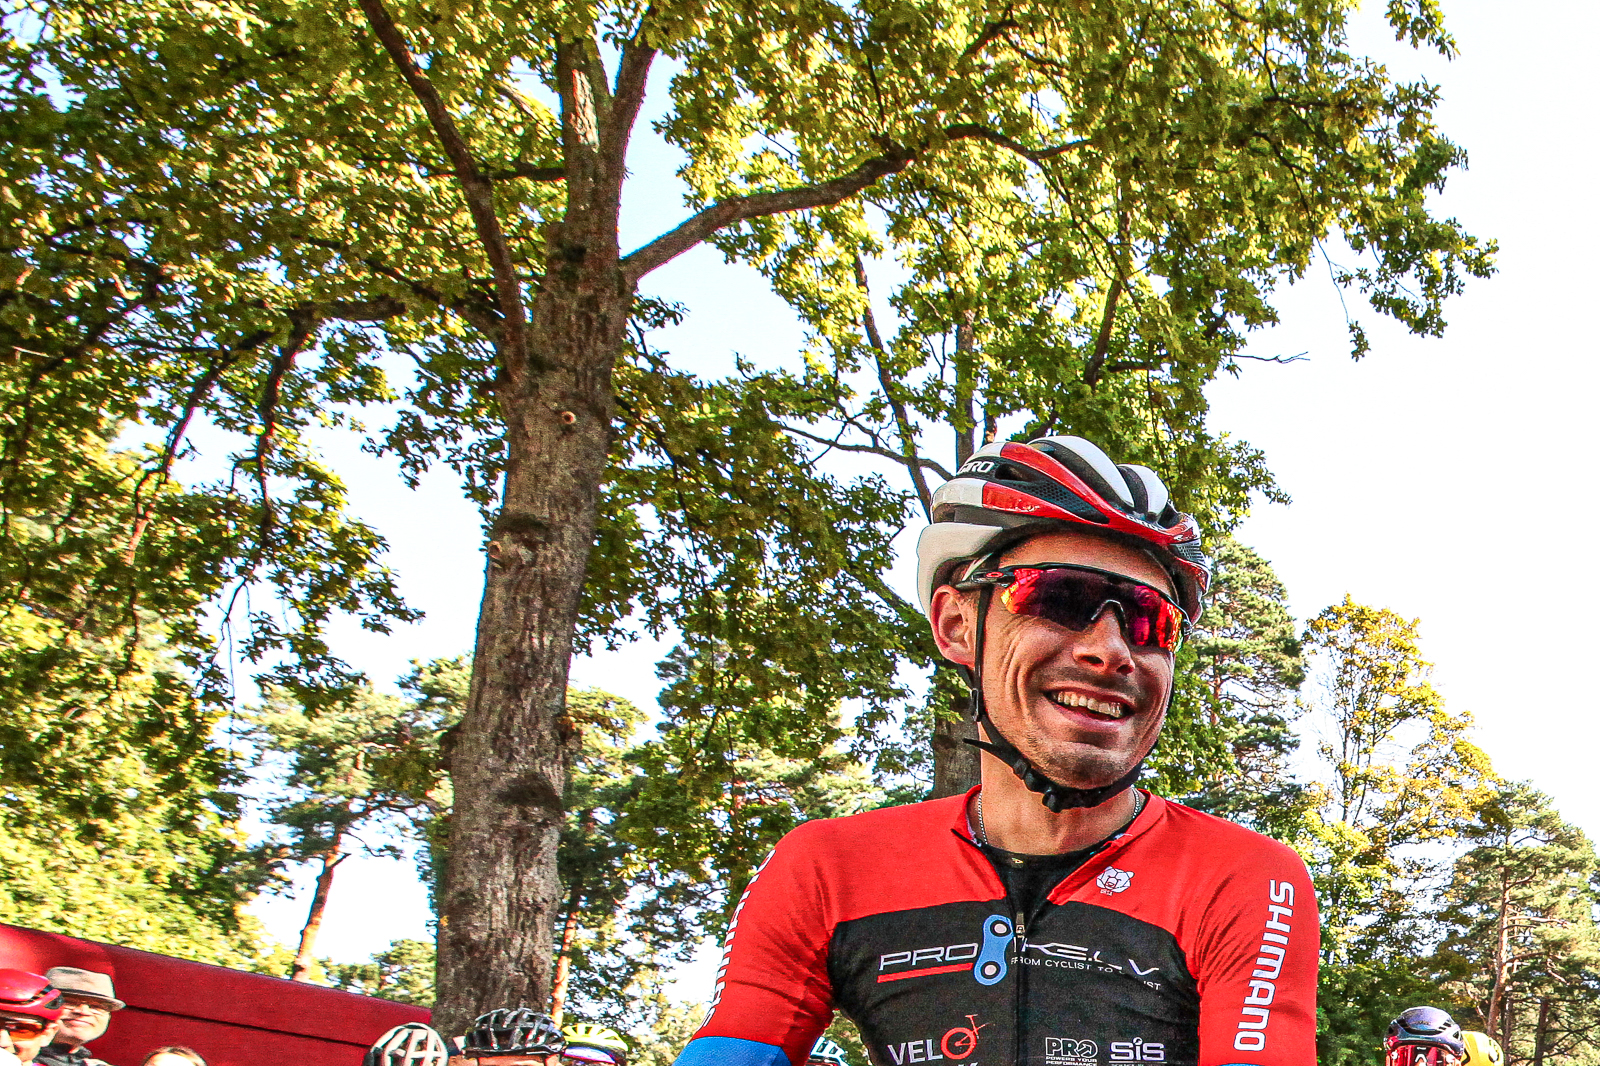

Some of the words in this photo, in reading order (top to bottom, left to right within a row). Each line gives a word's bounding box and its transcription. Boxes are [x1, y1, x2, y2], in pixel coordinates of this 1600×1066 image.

[1044, 959, 1091, 971] CYCLIST
[1233, 879, 1295, 1052] SHIMANO
[1045, 1037, 1098, 1059] PRO
